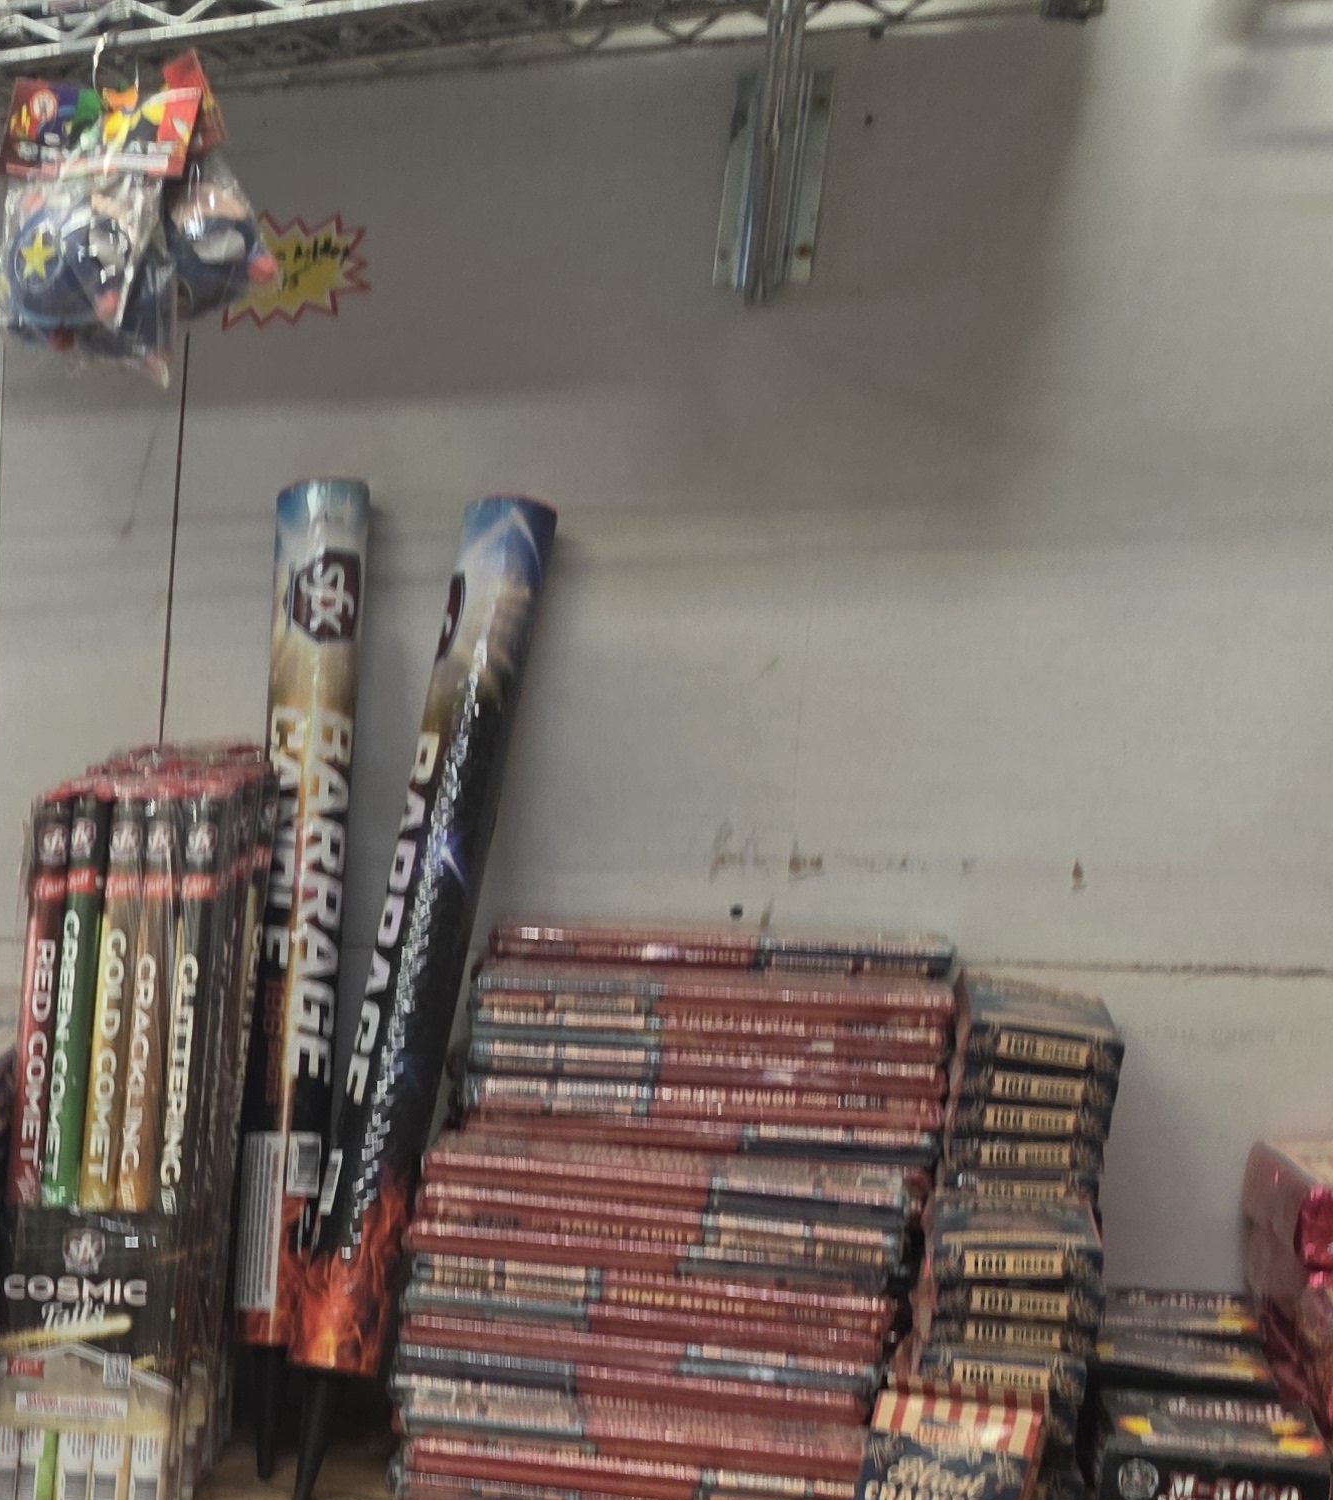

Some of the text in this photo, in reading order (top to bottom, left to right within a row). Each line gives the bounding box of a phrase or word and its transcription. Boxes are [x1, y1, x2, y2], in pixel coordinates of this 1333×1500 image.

[288, 706, 355, 1087] BARRAGE
[20, 939, 56, 1172] RED COMET
[44, 909, 81, 1182] GREEN COMET
[87, 927, 127, 1184] GOLD COMET
[119, 953, 157, 1174] CRACKLING
[159, 953, 199, 1184] GLITTERING
[3, 1272, 148, 1307] COSMIC
